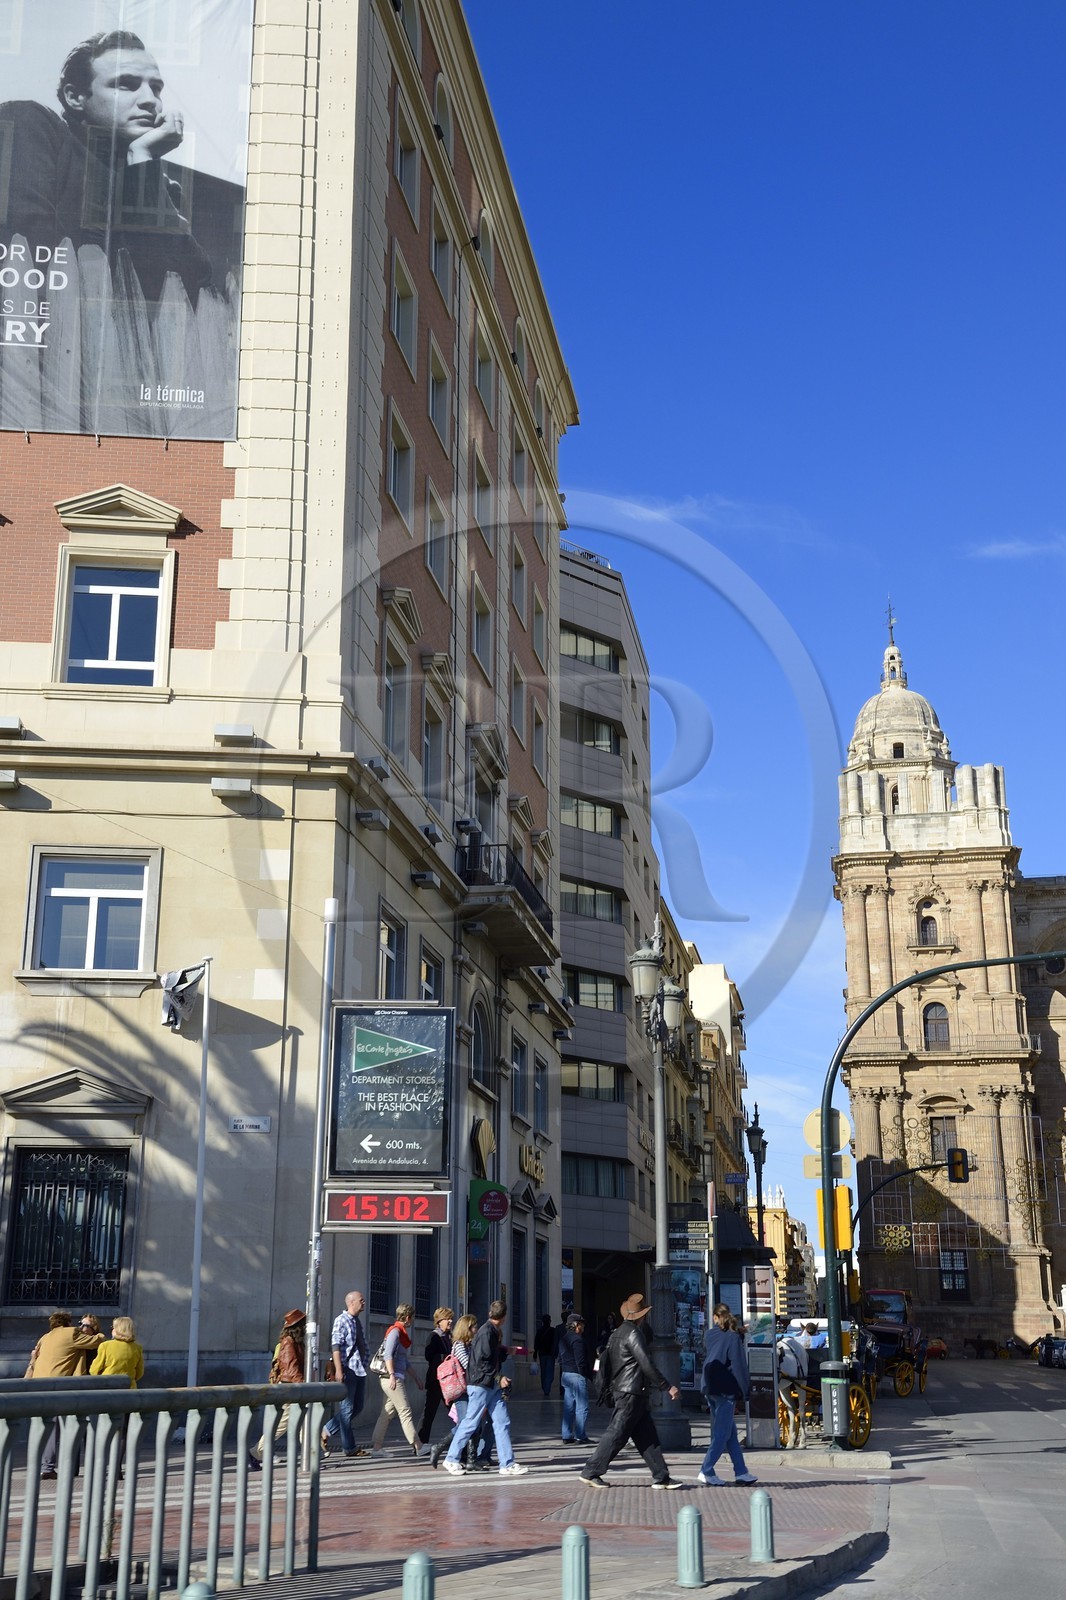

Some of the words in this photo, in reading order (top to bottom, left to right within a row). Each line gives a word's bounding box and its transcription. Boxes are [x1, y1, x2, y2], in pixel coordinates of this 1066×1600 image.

[35, 246, 68, 264] DE
[23, 301, 50, 316] DE
[5, 320, 51, 343] RY
[140, 383, 151, 400] la
[156, 384, 205, 403] térmica
[365, 1044, 384, 1053] Corte
[352, 1075, 403, 1084] DEPARTMENT
[405, 1076, 436, 1085] STORES
[358, 1092, 375, 1102] THE
[377, 1092, 399, 1102] BEST
[401, 1093, 429, 1103] PLACE
[365, 1102, 376, 1111] IN
[378, 1102, 421, 1112] FASHION
[385, 1140, 404, 1150] 600
[405, 1141, 423, 1150] mts.
[352, 1157, 378, 1165] Avenida
[378, 1157, 387, 1165] de
[342, 1195, 430, 1222] 15:02
